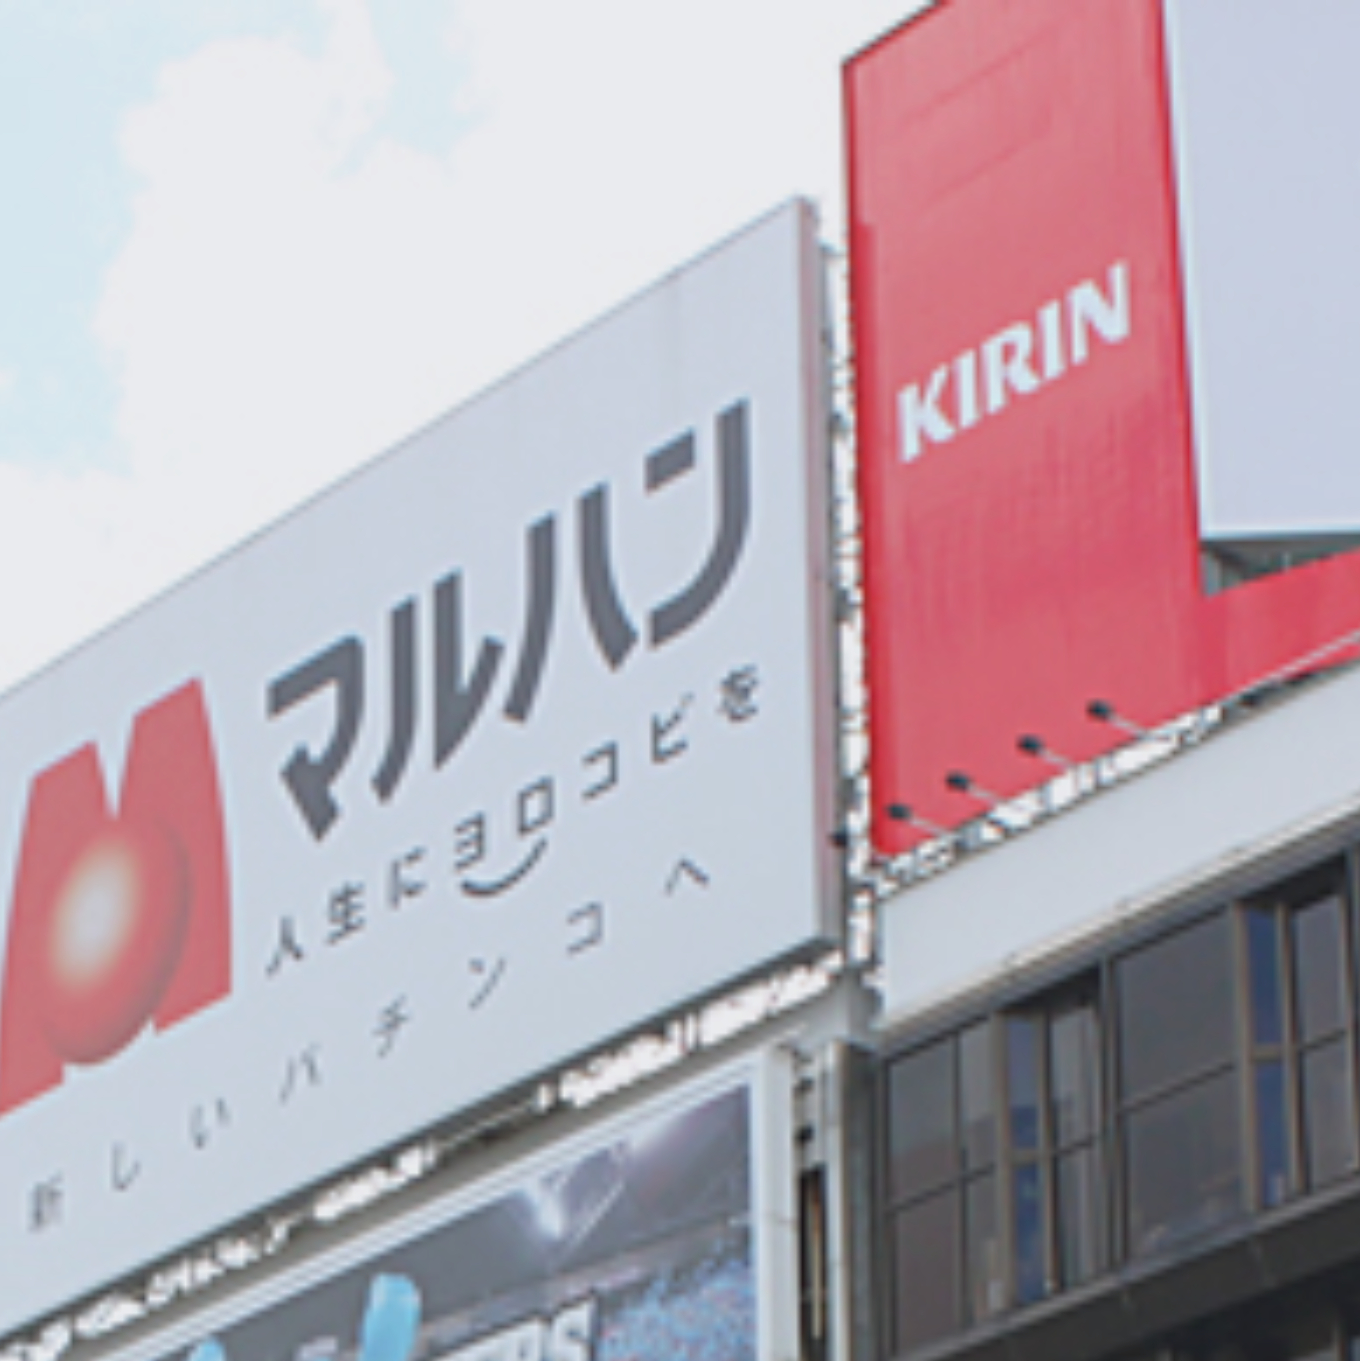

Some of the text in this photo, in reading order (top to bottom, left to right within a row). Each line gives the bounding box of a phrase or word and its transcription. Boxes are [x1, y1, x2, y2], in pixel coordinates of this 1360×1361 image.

[896, 262, 1132, 464] KIRIN
[265, 396, 751, 844] マルハン
[266, 663, 762, 977] 人生にヨロコビを
